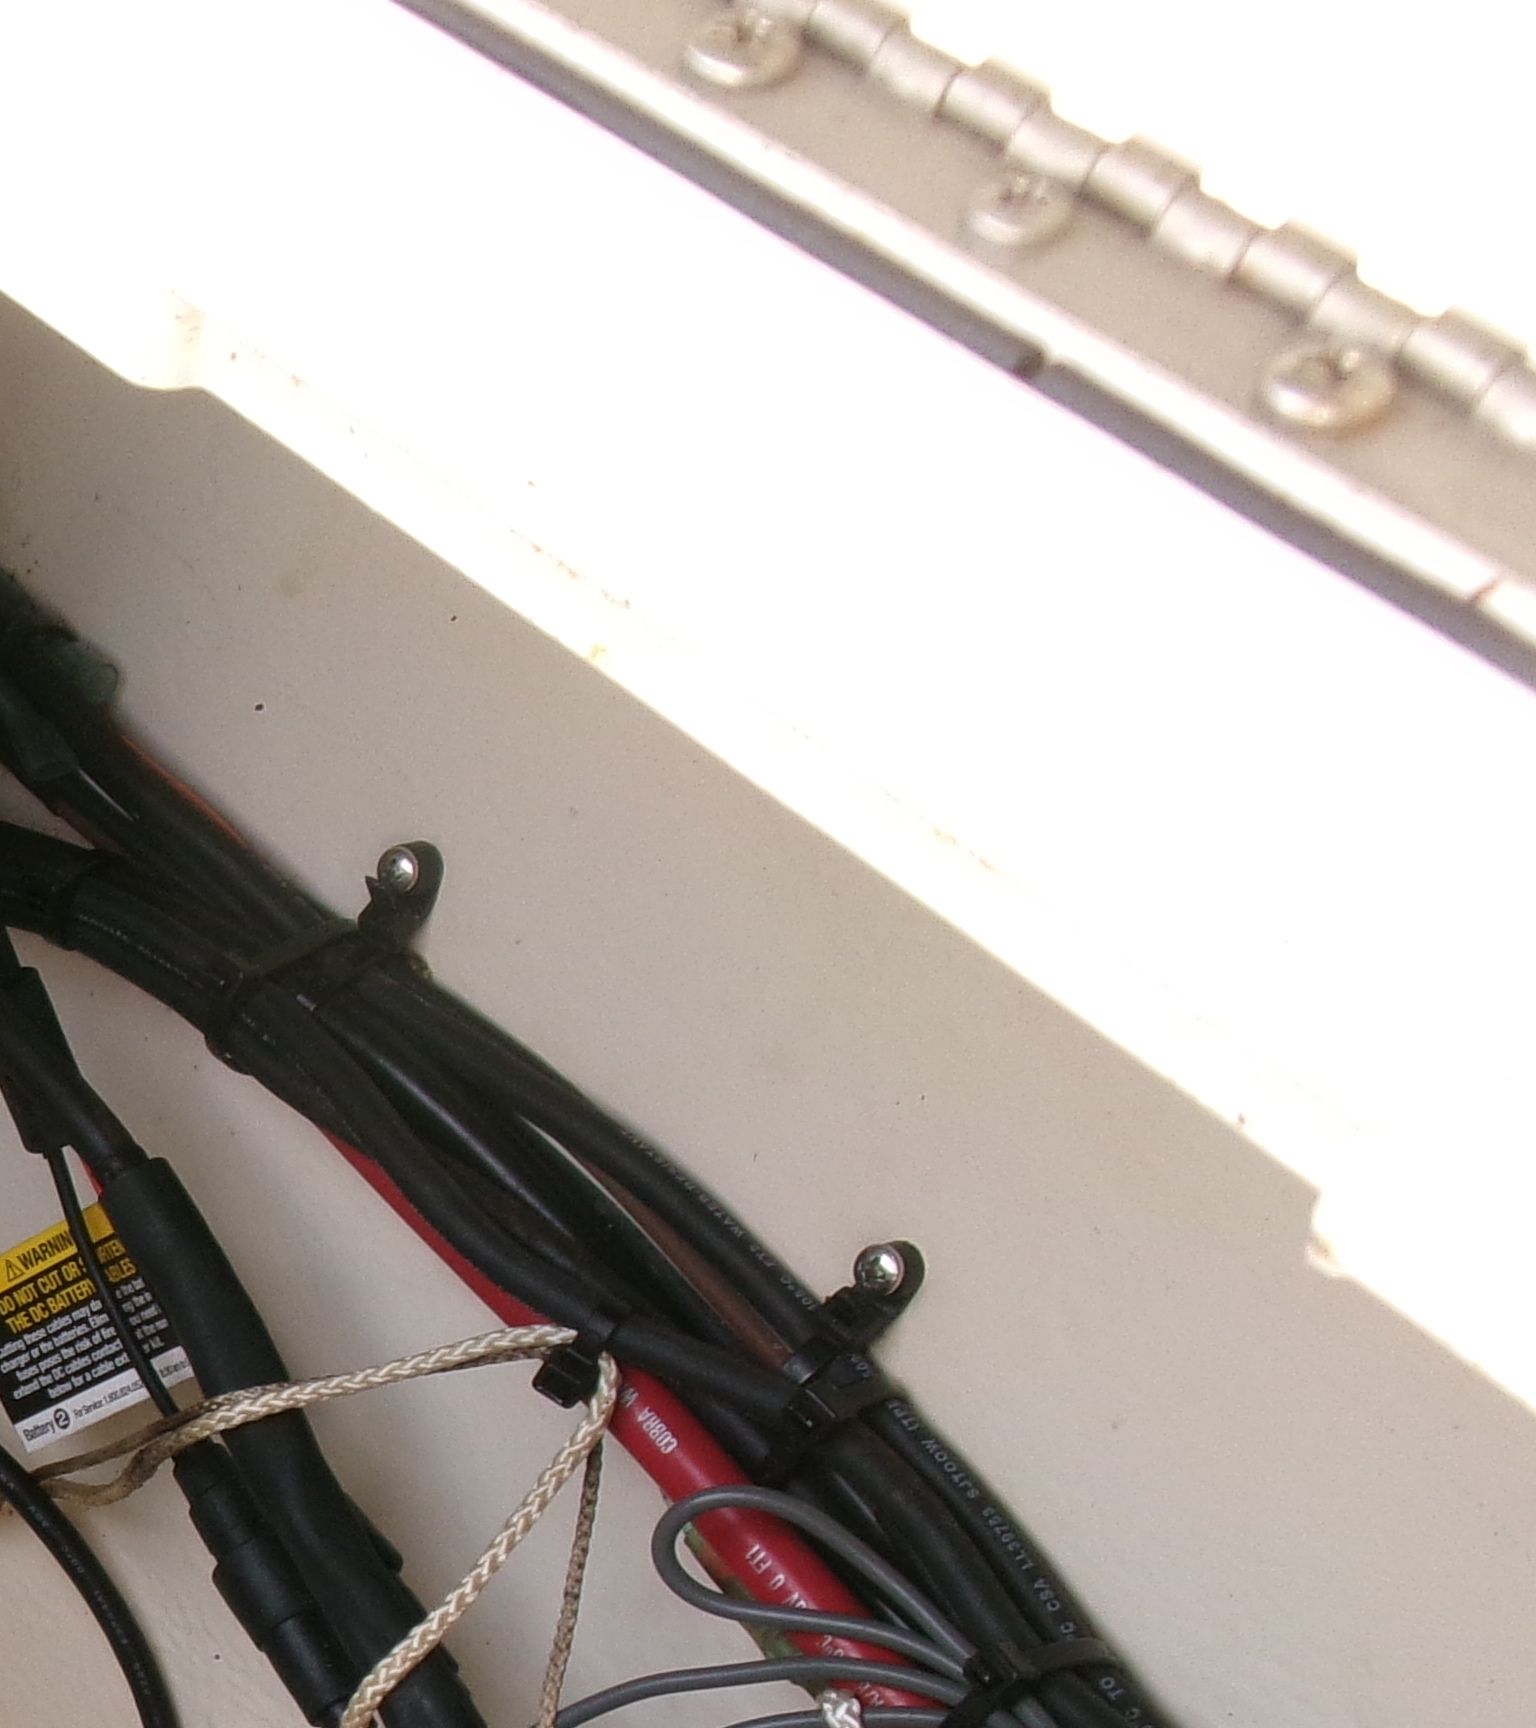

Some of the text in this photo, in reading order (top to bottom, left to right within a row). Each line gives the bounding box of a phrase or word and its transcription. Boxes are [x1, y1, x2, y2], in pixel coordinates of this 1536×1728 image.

[18, 1229, 75, 1270] WARNIN
[13, 1283, 39, 1308] NOT
[37, 1270, 64, 1293] CUT
[61, 1261, 81, 1282] OR
[5, 1310, 32, 1335] THE
[29, 1302, 49, 1323] DC
[23, 1416, 56, 1442] Battery
[634, 1405, 680, 1455] COBRA
[1030, 1575, 1063, 1614] CSA
